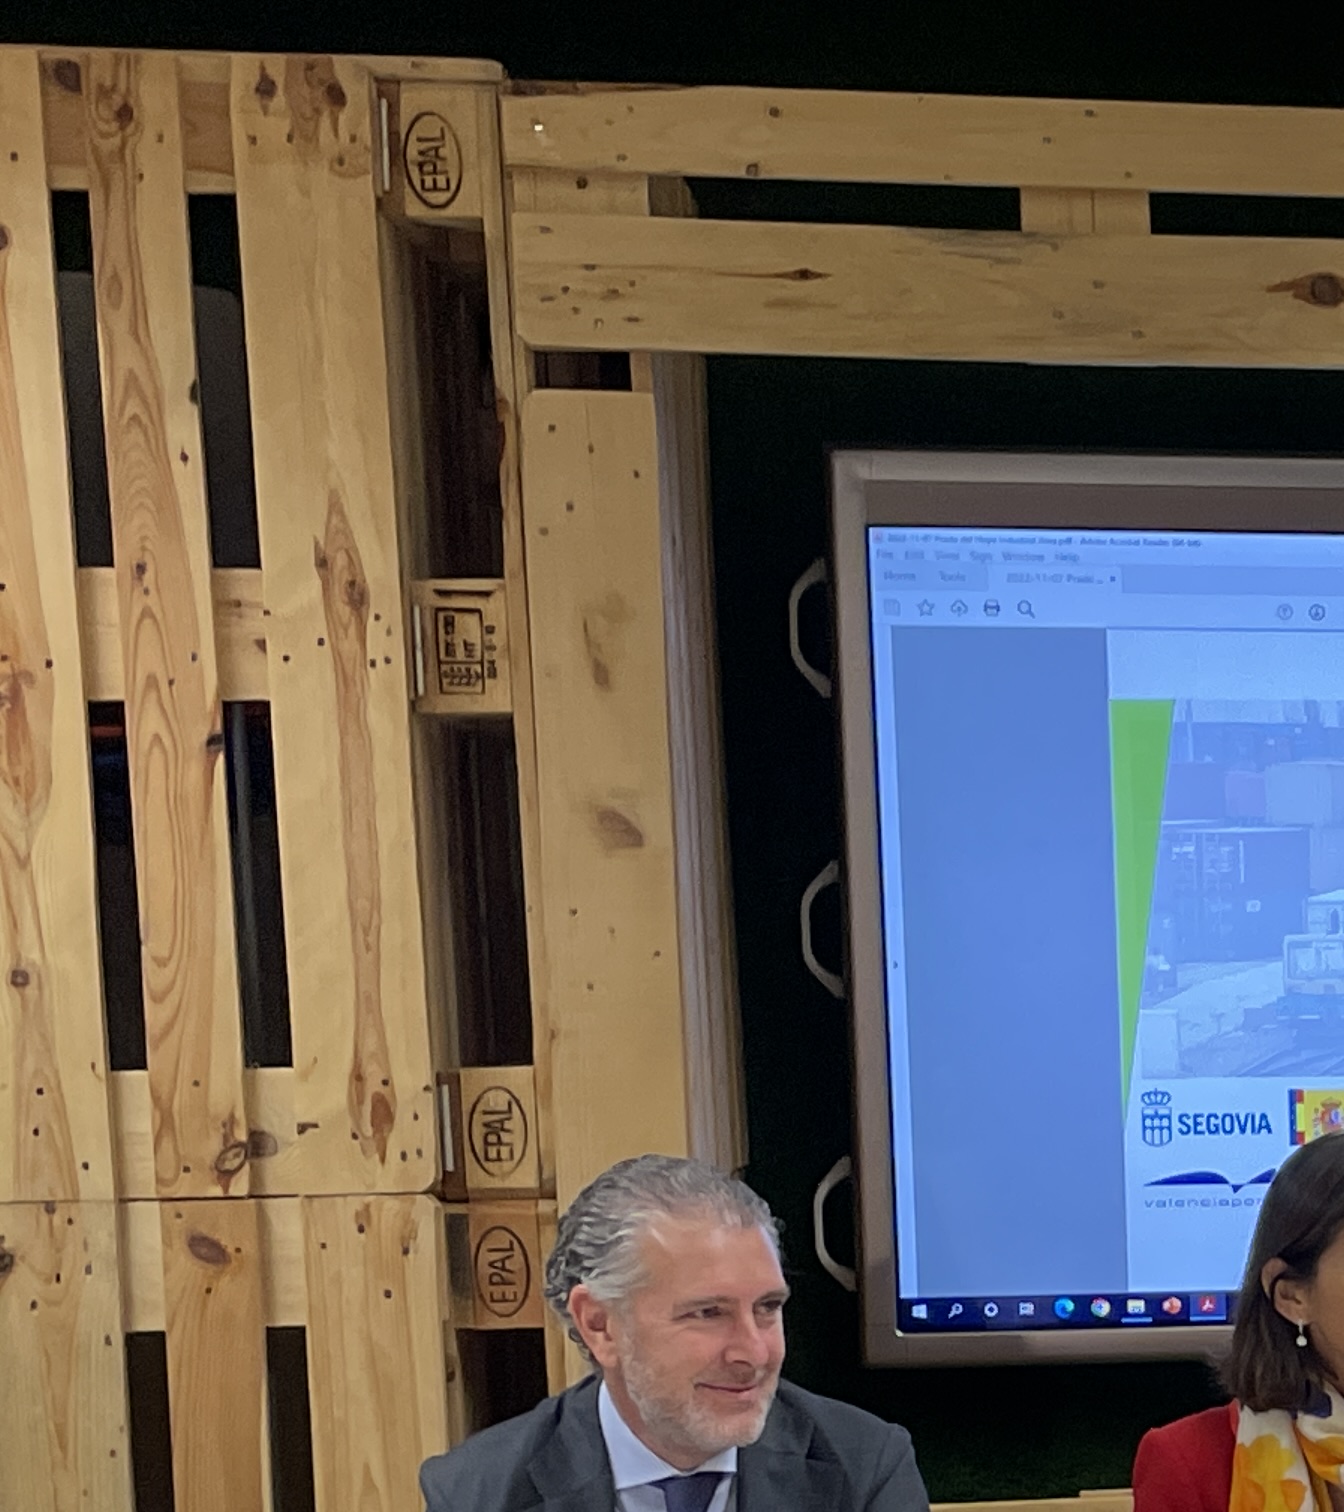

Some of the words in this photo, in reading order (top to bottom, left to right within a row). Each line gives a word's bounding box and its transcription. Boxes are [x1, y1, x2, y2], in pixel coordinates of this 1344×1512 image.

[415, 126, 450, 192] EPAL
[481, 1100, 514, 1162] EPAL
[1177, 1112, 1273, 1136] SEGOVIA
[487, 1238, 518, 1305] EPAL
